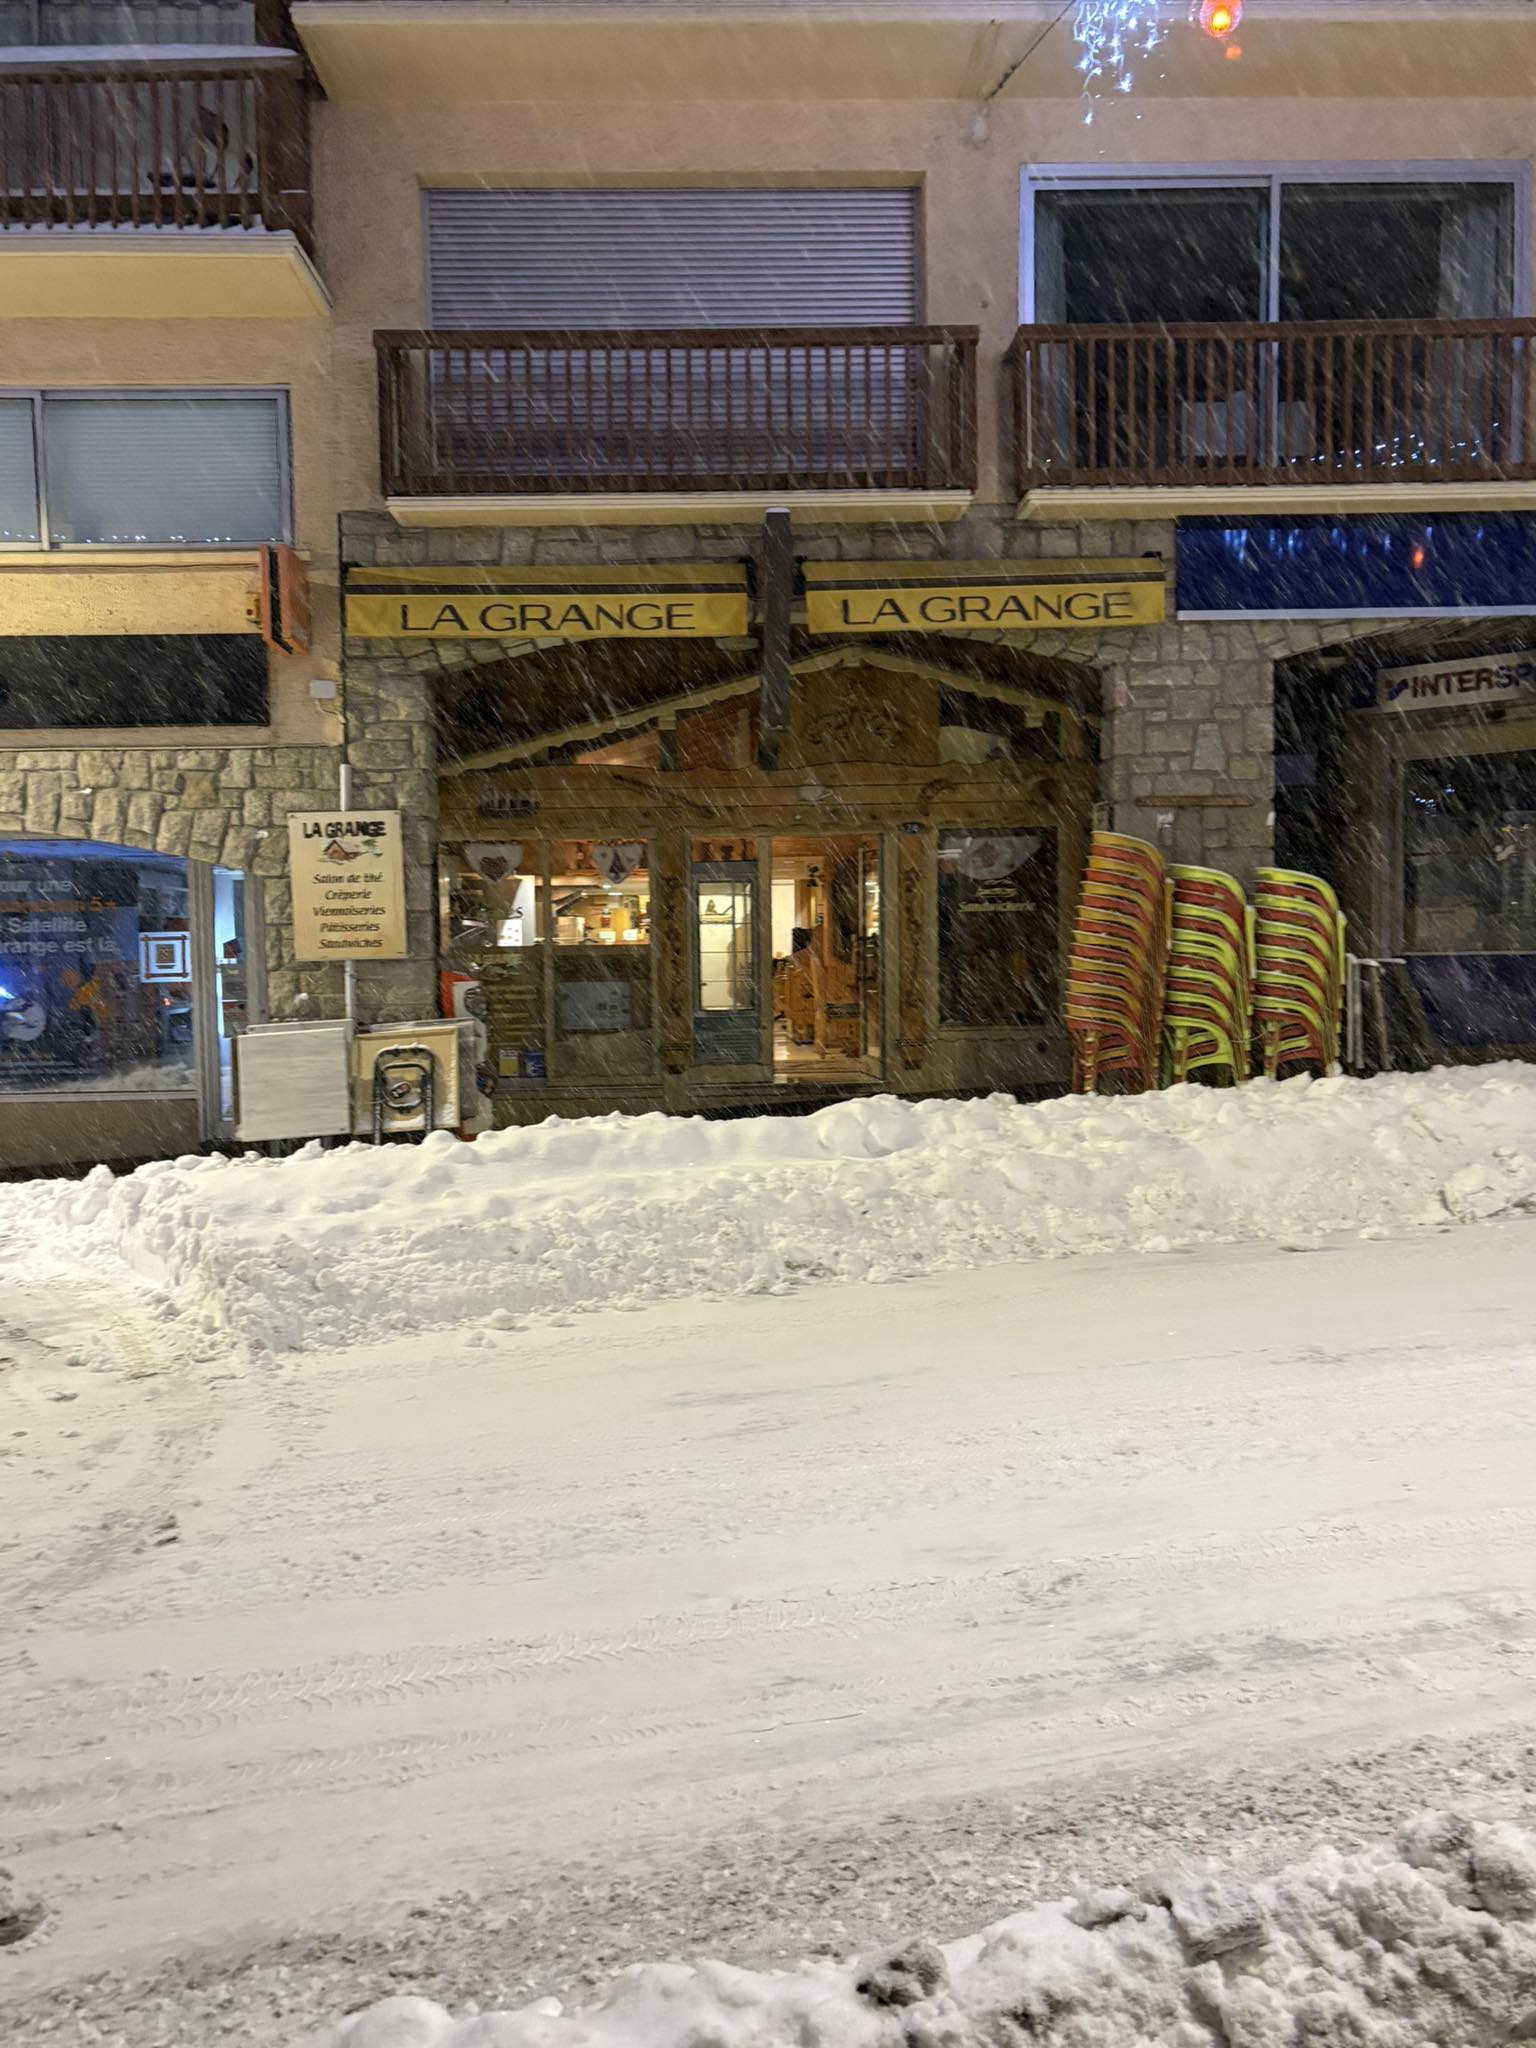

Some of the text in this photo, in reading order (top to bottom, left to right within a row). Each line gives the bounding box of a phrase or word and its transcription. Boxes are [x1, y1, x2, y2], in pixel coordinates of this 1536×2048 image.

[401, 602, 697, 632] LA GRANGE
[841, 591, 1135, 626] LA GRANGE
[1412, 660, 1536, 698] INTERSP
[302, 820, 387, 839] LA GRANGE
[312, 871, 383, 884] Salon de thé
[324, 888, 373, 901] Crêperie
[8, 916, 87, 934] Satellite
[0, 940, 60, 957] range
[62, 938, 94, 953] est
[318, 938, 383, 950] Sandwiches
